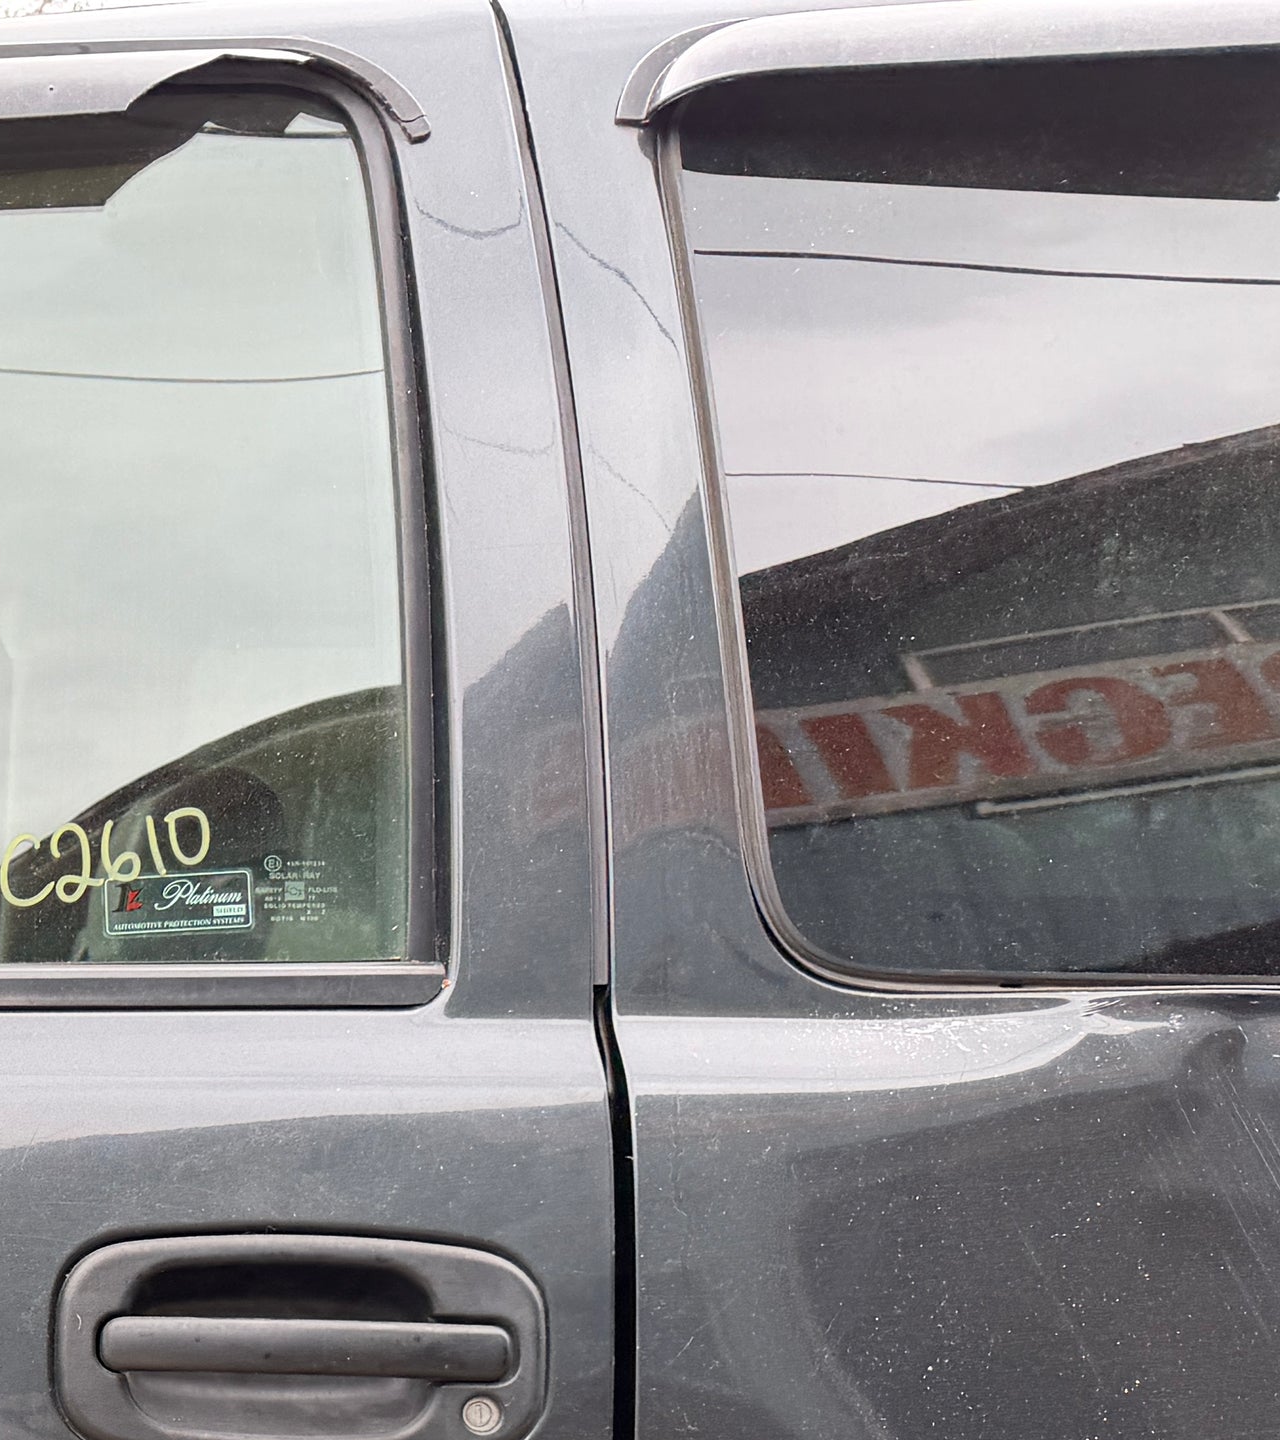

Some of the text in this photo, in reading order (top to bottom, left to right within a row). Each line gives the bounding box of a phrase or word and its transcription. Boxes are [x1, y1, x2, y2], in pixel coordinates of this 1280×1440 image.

[0, 807, 211, 907] C2610
[268, 871, 298, 880] SOLAR
[154, 879, 243, 911] Platinum
[112, 917, 245, 931] AUTOMOTIVE PROTECTION SYSTEMS
